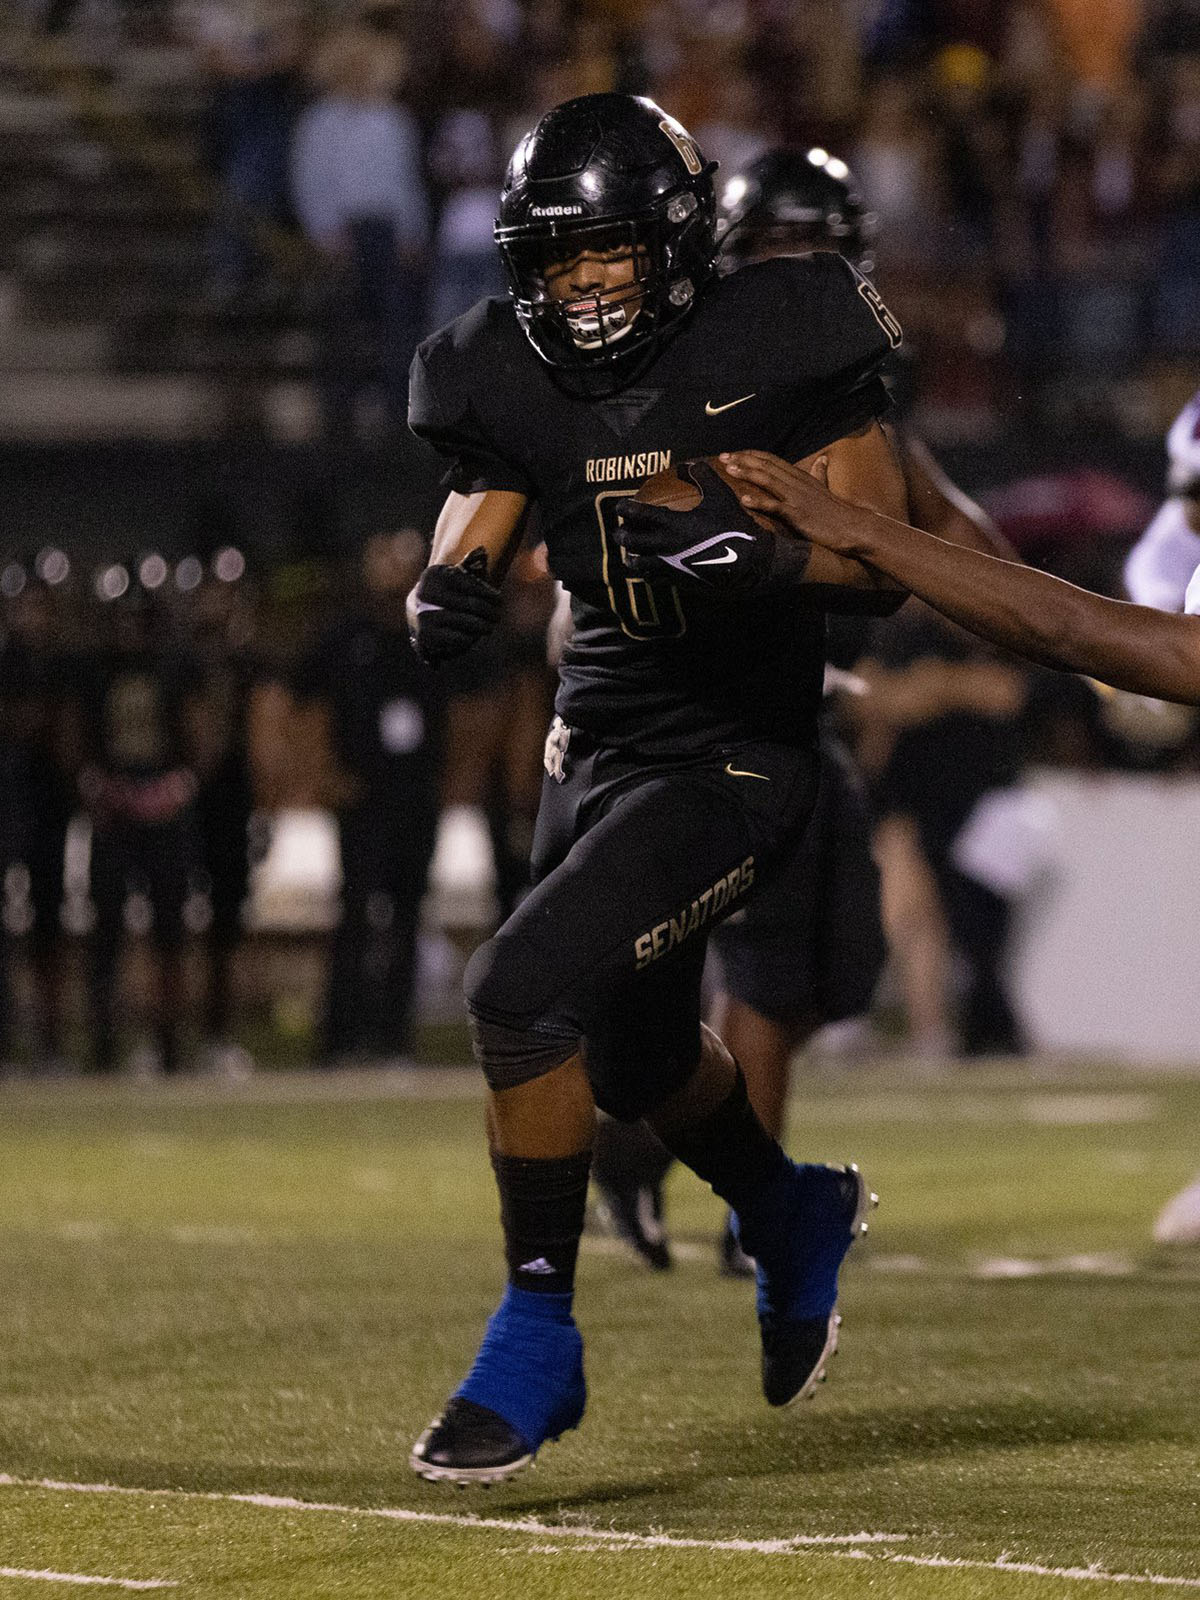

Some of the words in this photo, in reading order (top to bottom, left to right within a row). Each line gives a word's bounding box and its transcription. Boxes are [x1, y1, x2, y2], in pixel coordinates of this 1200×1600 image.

[658, 120, 703, 175] 6
[857, 282, 903, 349] 6
[586, 449, 671, 483] ROBINSON
[595, 488, 688, 642] 6
[634, 855, 755, 971] SENATORS
